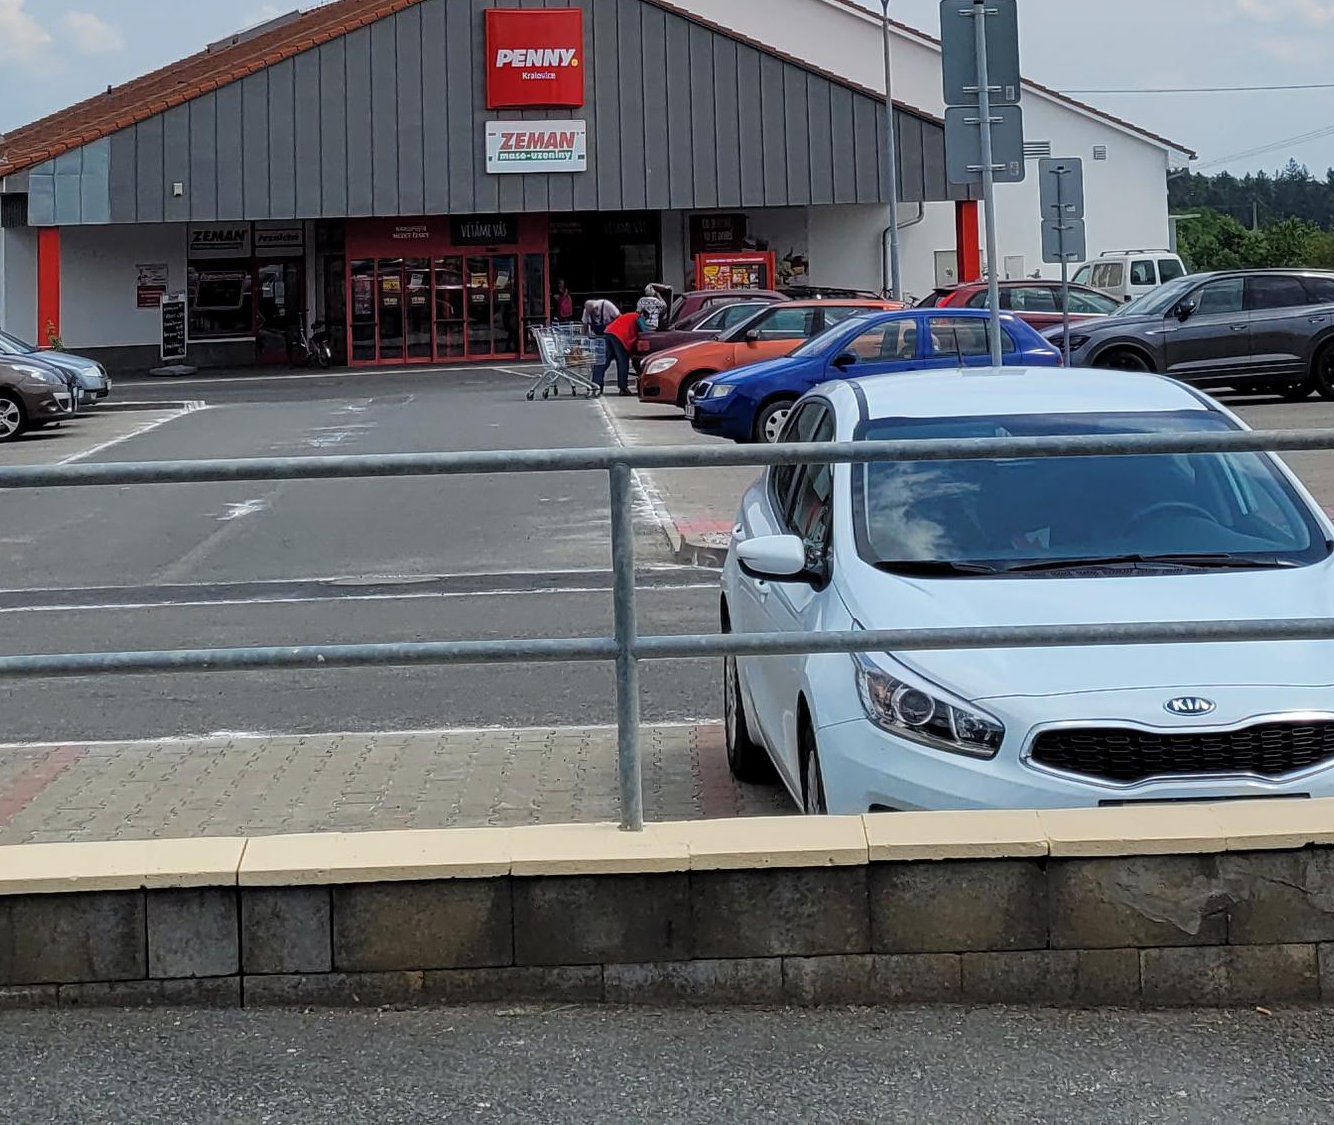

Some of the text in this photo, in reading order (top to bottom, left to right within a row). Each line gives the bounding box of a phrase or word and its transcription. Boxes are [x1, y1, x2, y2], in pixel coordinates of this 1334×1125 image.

[500, 132, 575, 150] ZEMAN
[499, 150, 572, 161] maso-uzeniny
[192, 230, 247, 242] ZEMAN
[1172, 698, 1210, 711] KIA
